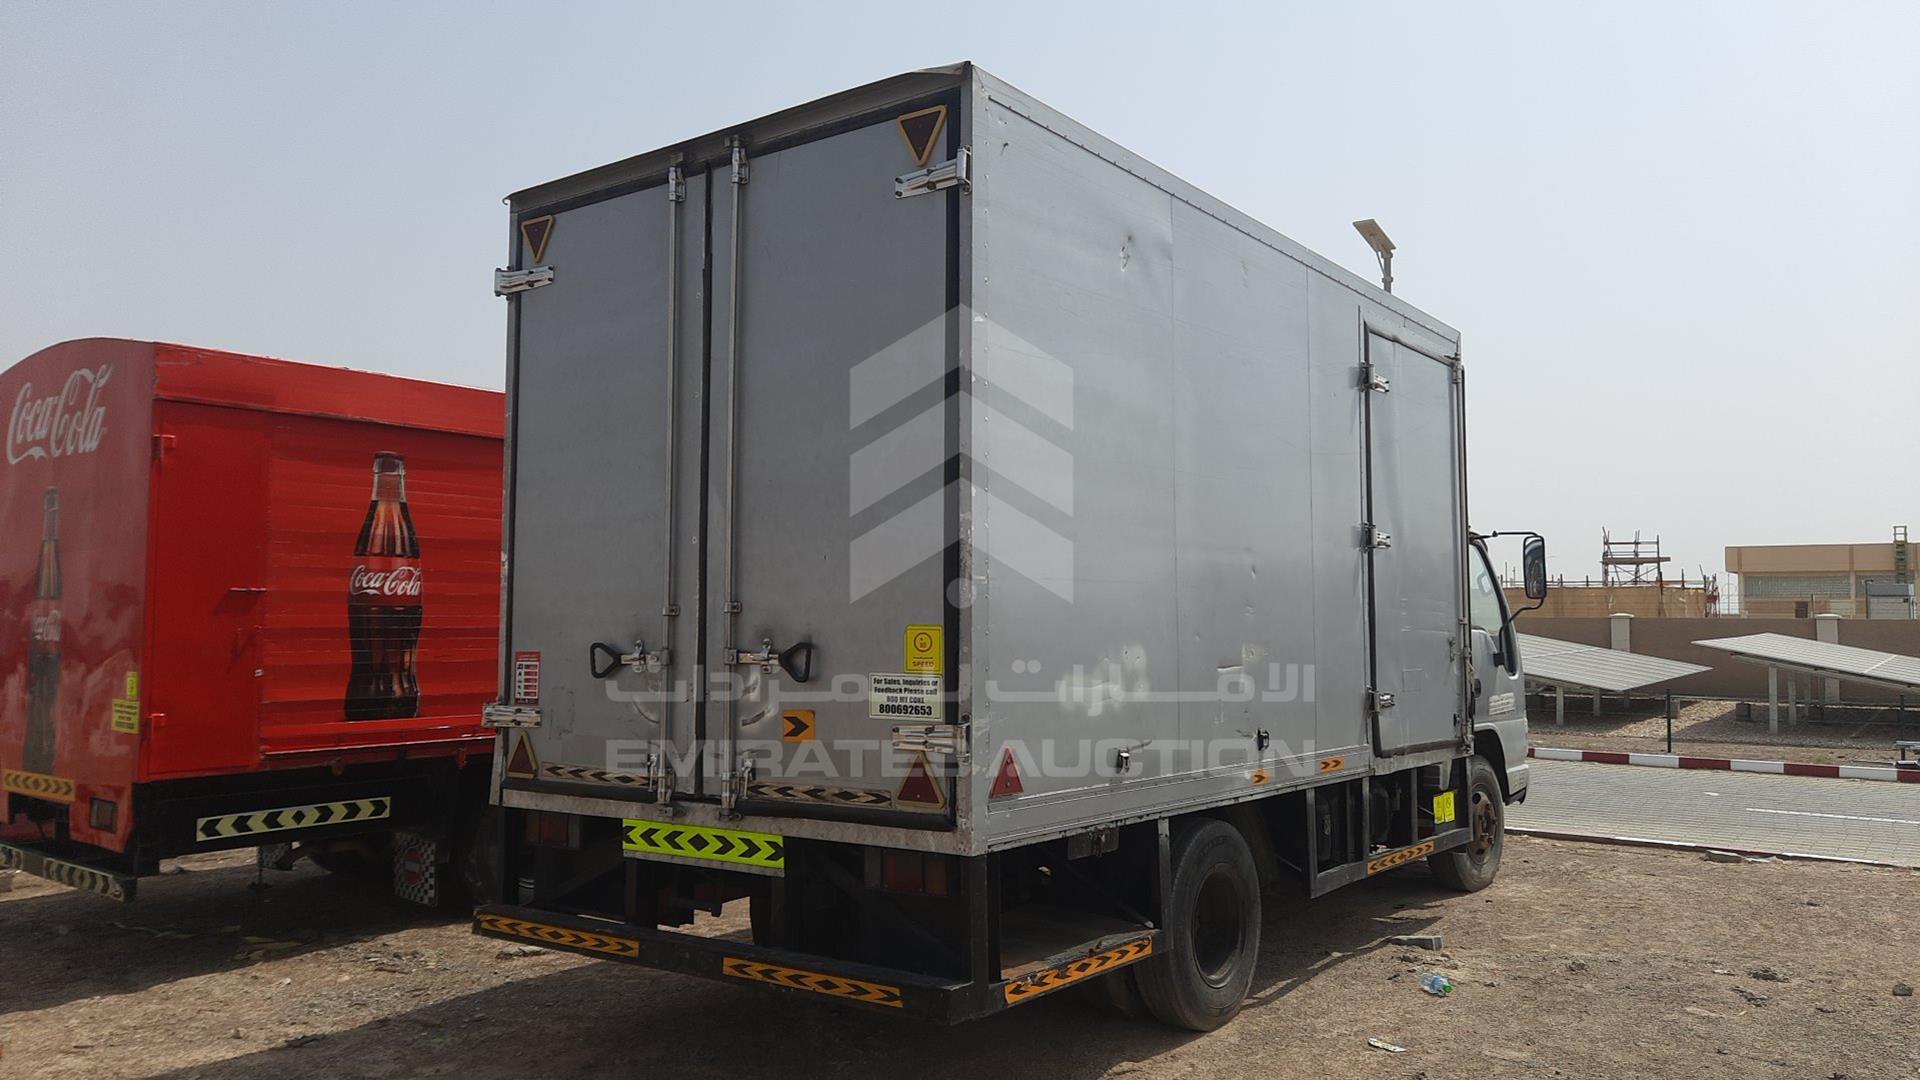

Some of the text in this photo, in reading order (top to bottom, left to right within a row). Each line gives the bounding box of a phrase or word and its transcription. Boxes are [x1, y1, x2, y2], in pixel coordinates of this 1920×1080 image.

[350, 565, 422, 596] Coca-Cola
[873, 677, 883, 685] For
[903, 679, 930, 687] Inquiries
[874, 686, 938, 696] Feedback Please call
[879, 704, 932, 716] 800692653
